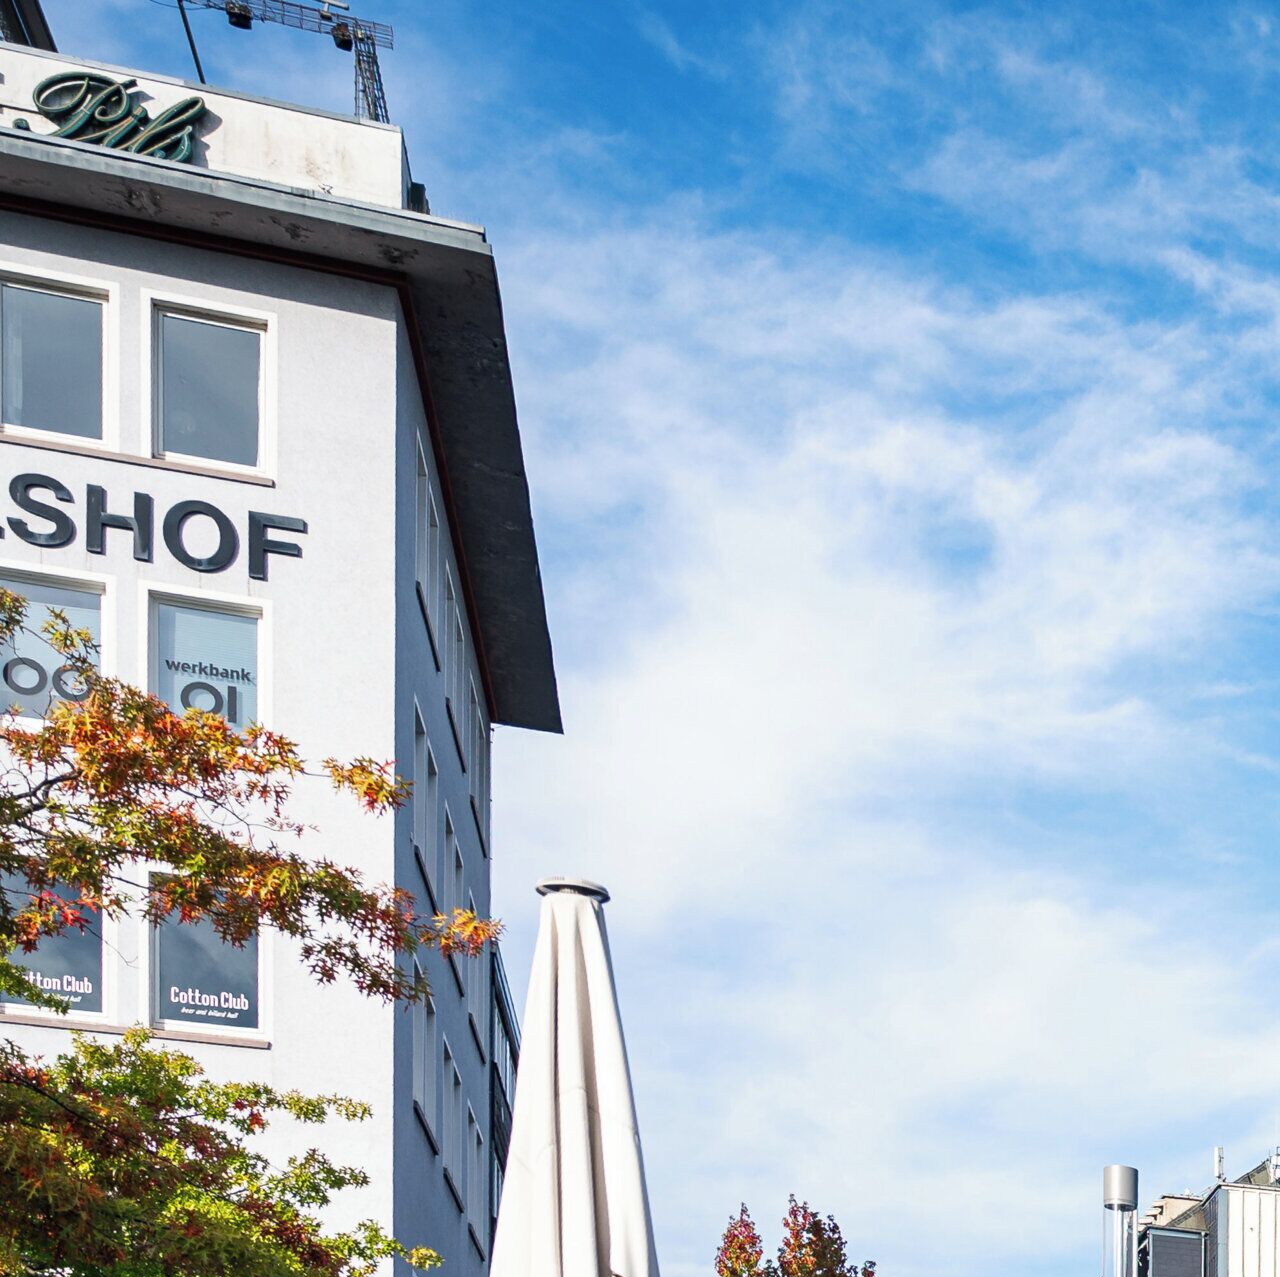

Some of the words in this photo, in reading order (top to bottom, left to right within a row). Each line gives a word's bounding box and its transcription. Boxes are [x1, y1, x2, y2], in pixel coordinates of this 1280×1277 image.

[0, 473, 308, 581] SHOF
[165, 659, 252, 682] werkbank
[25, 971, 61, 992] tton
[63, 974, 93, 995] Club
[170, 986, 219, 1008] Cotton
[220, 992, 249, 1011] Club
